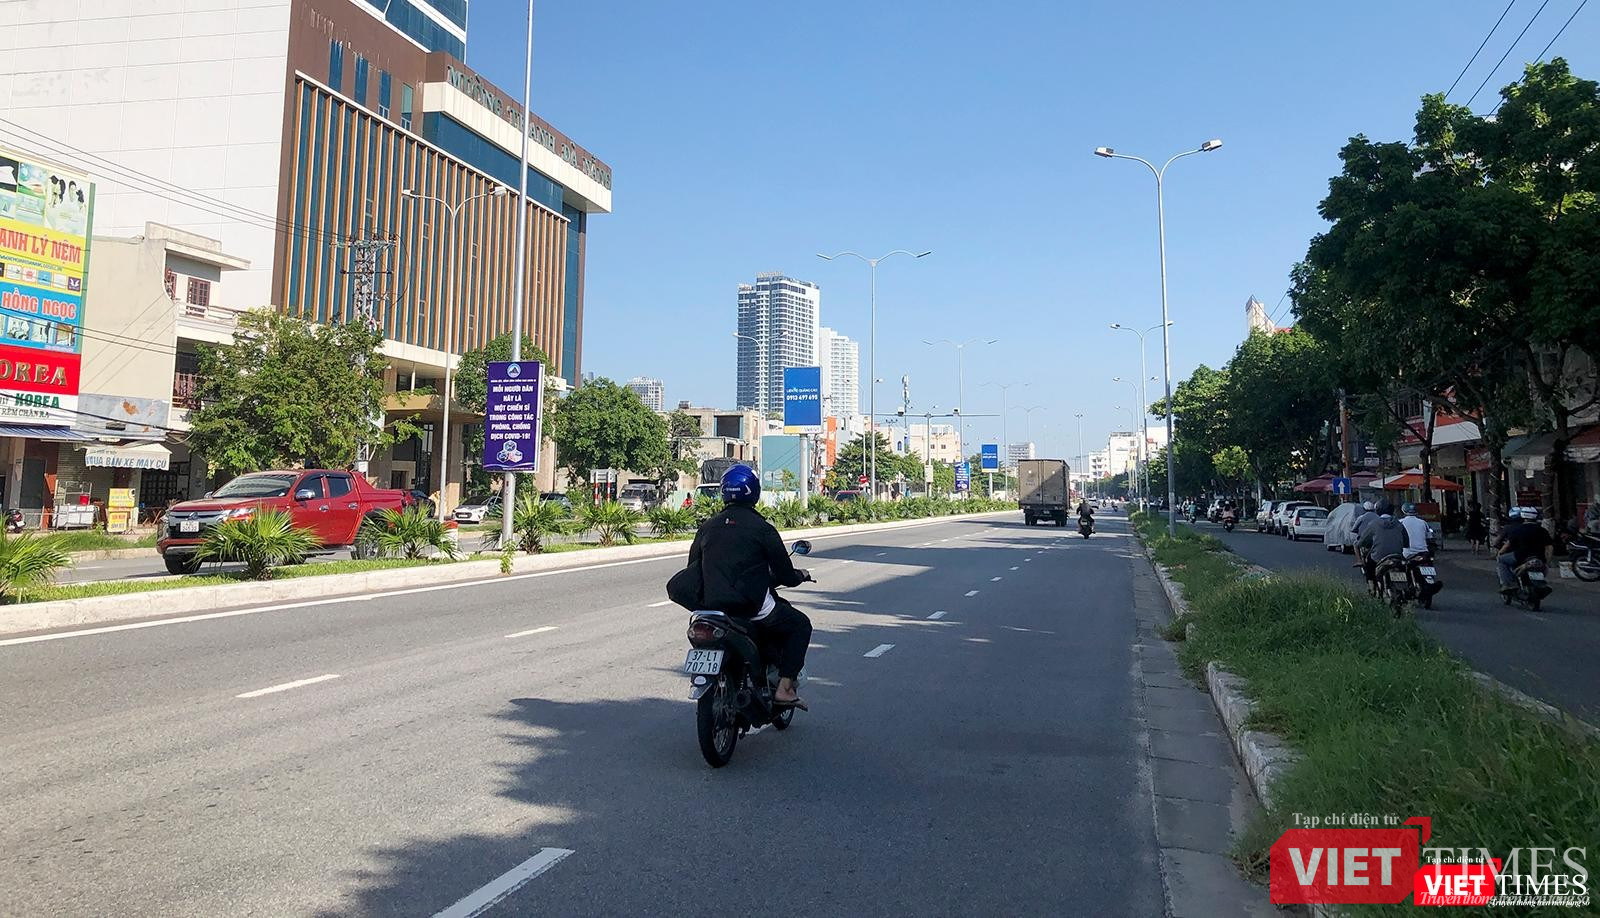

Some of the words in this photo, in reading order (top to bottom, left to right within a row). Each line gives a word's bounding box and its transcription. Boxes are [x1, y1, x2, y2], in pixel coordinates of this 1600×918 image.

[31, 234, 48, 256] LÝ
[51, 239, 81, 265] NỆM
[42, 298, 77, 321] NGỌC
[15, 393, 60, 409] KOREA
[508, 413, 523, 421] CÔNG
[524, 413, 534, 421] TÁC
[692, 651, 717, 662] 37-L1
[686, 661, 718, 672] 707.18
